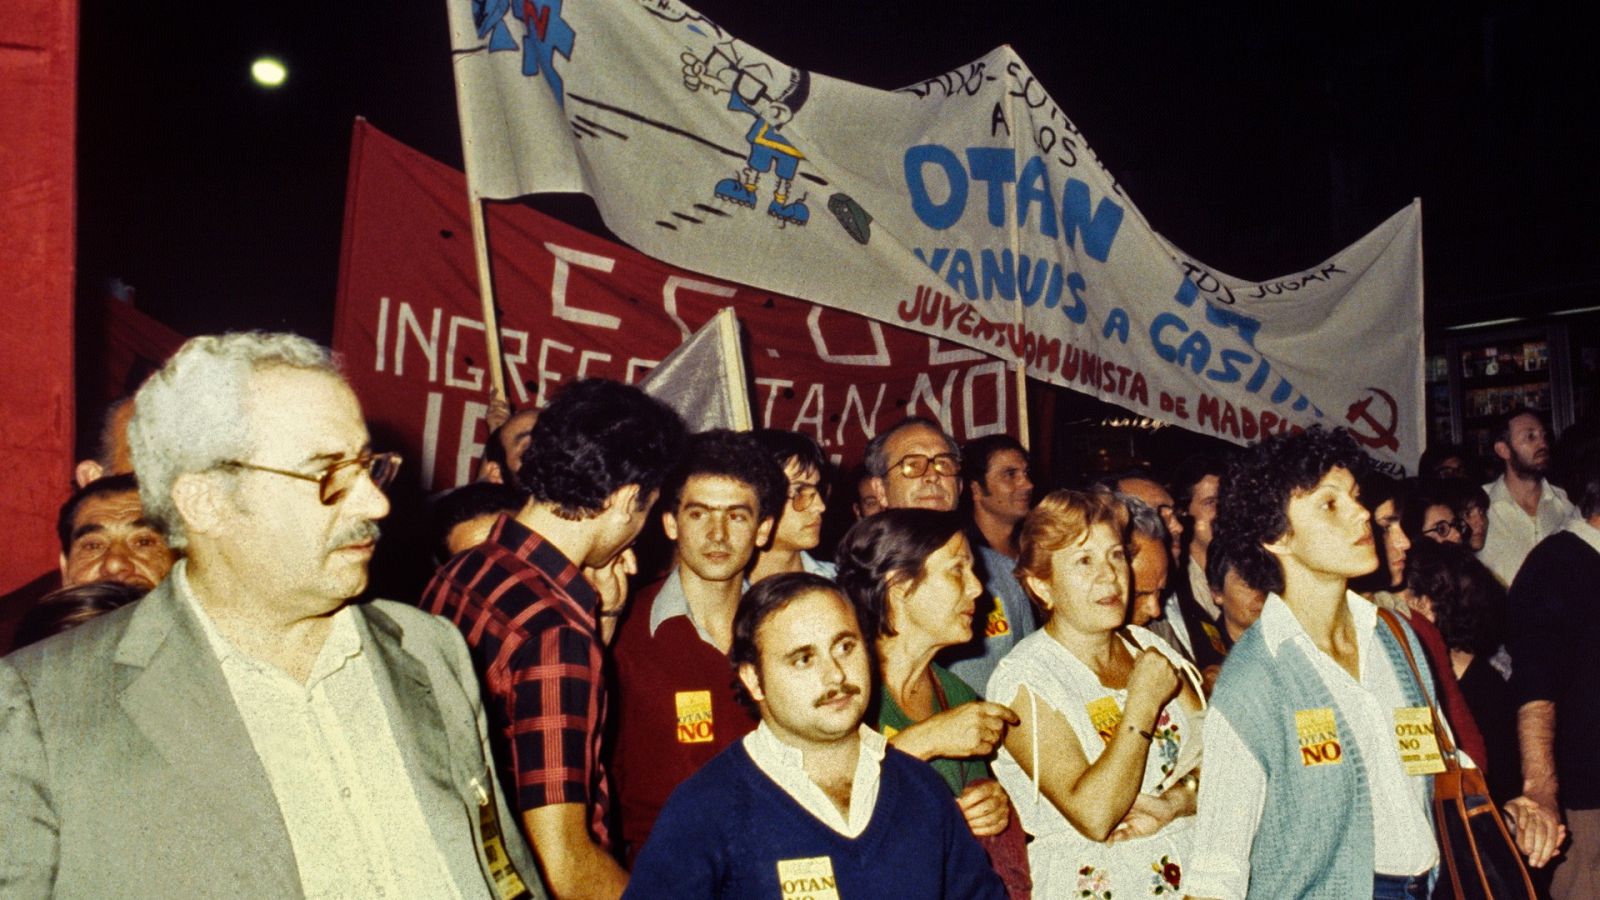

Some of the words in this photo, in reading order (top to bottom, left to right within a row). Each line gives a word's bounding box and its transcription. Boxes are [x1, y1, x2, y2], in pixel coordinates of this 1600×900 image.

[903, 142, 1125, 261] OTAN
[1103, 307, 1131, 345] A
[897, 284, 1025, 358] JUVENTU
[1024, 330, 1150, 407] OMUNISTA
[1159, 391, 1190, 420] DE
[1197, 393, 1306, 443] MADRI
[679, 720, 714, 741] NO
[1395, 723, 1435, 737] OTAN
[1301, 740, 1342, 767] NO
[1398, 738, 1421, 751] NO
[782, 876, 836, 894] OTAN
